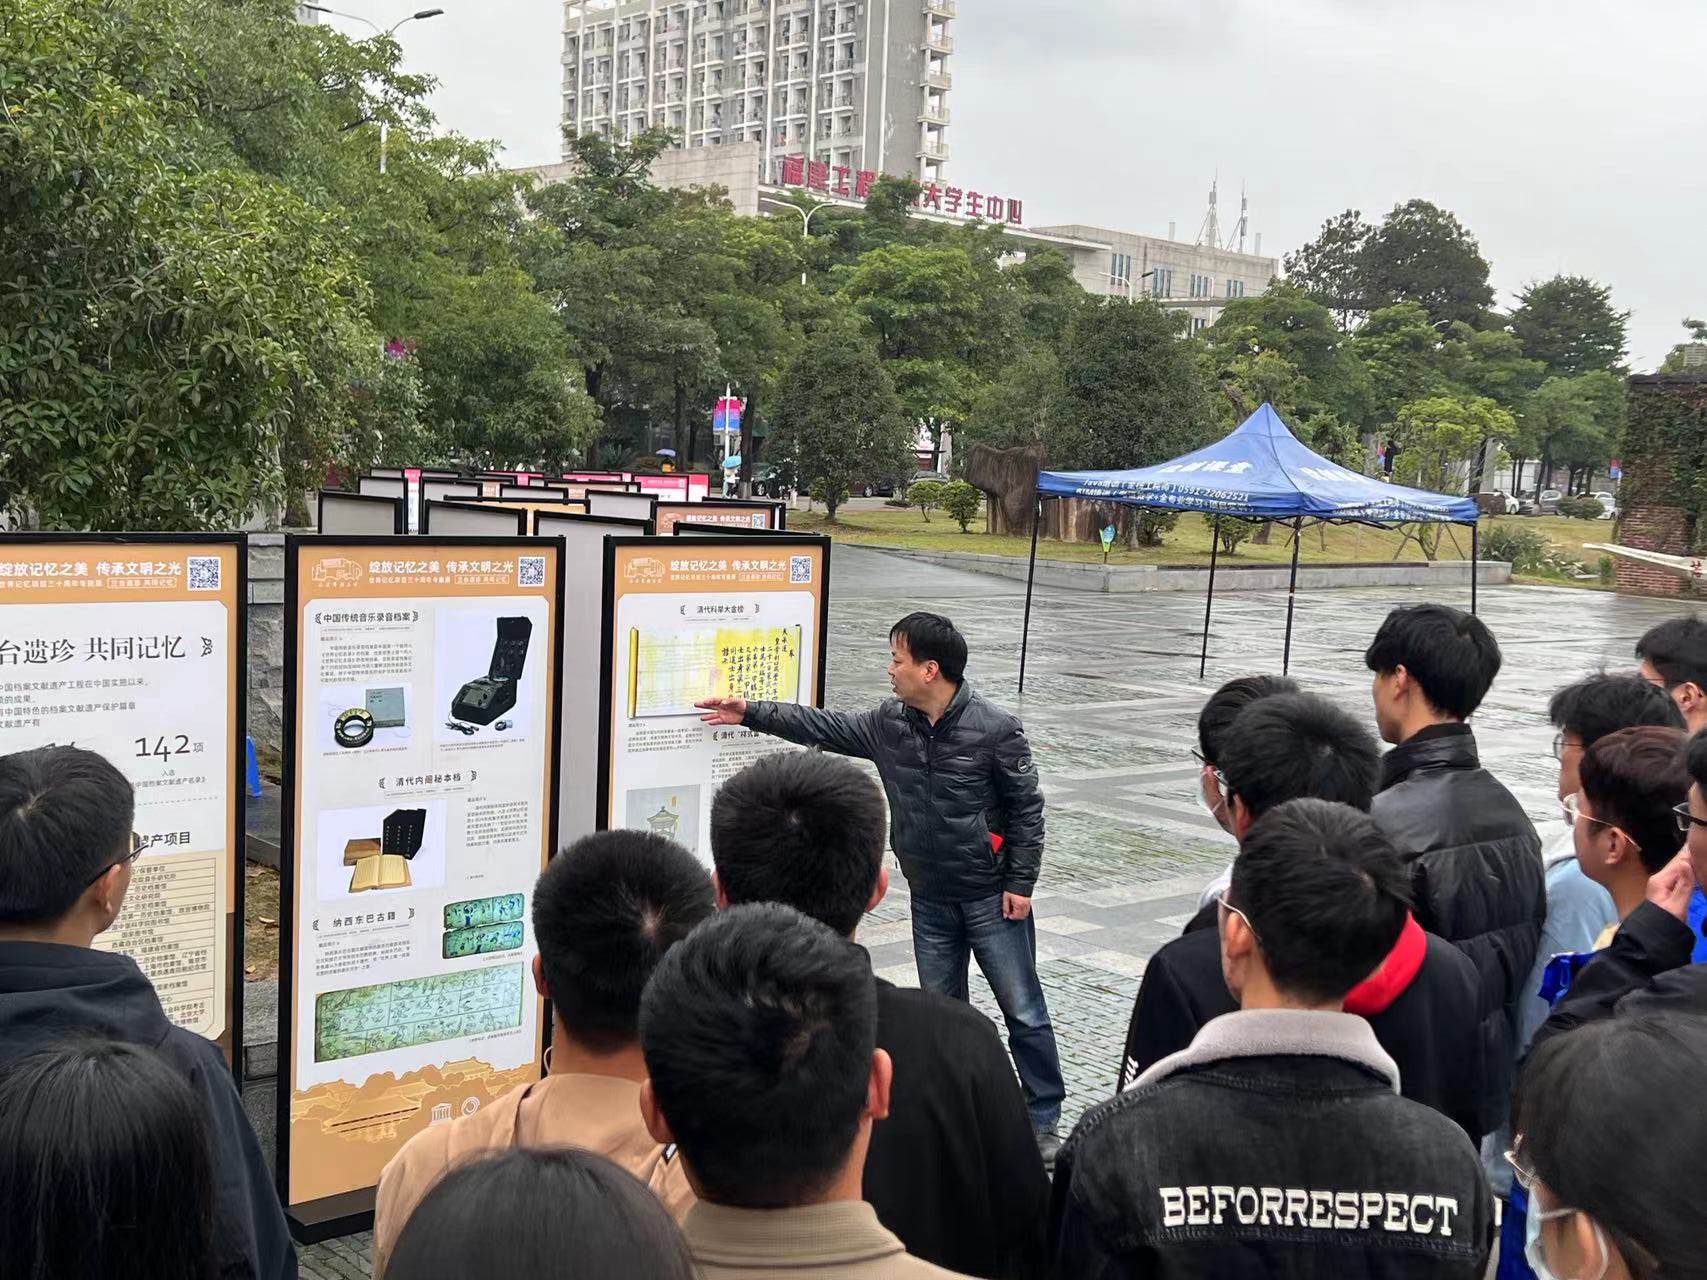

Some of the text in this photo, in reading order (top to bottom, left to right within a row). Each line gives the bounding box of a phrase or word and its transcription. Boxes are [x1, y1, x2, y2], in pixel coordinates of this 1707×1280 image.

[783, 153, 1022, 225] 福建工程大学生中心
[0, 561, 181, 576] 绽放记忆之美 传承文明之光
[369, 560, 513, 574] 绽放记忆之美 传承文明之光
[670, 560, 786, 571] 绽放记忆之美 传承文明之光
[323, 612, 411, 624] 中国传统音乐录音档案
[0, 635, 186, 665] 台遗珍 共同记忆
[333, 911, 396, 928] 纳西东巴古籍
[1159, 1185, 1458, 1237] BEFORRESPECT
